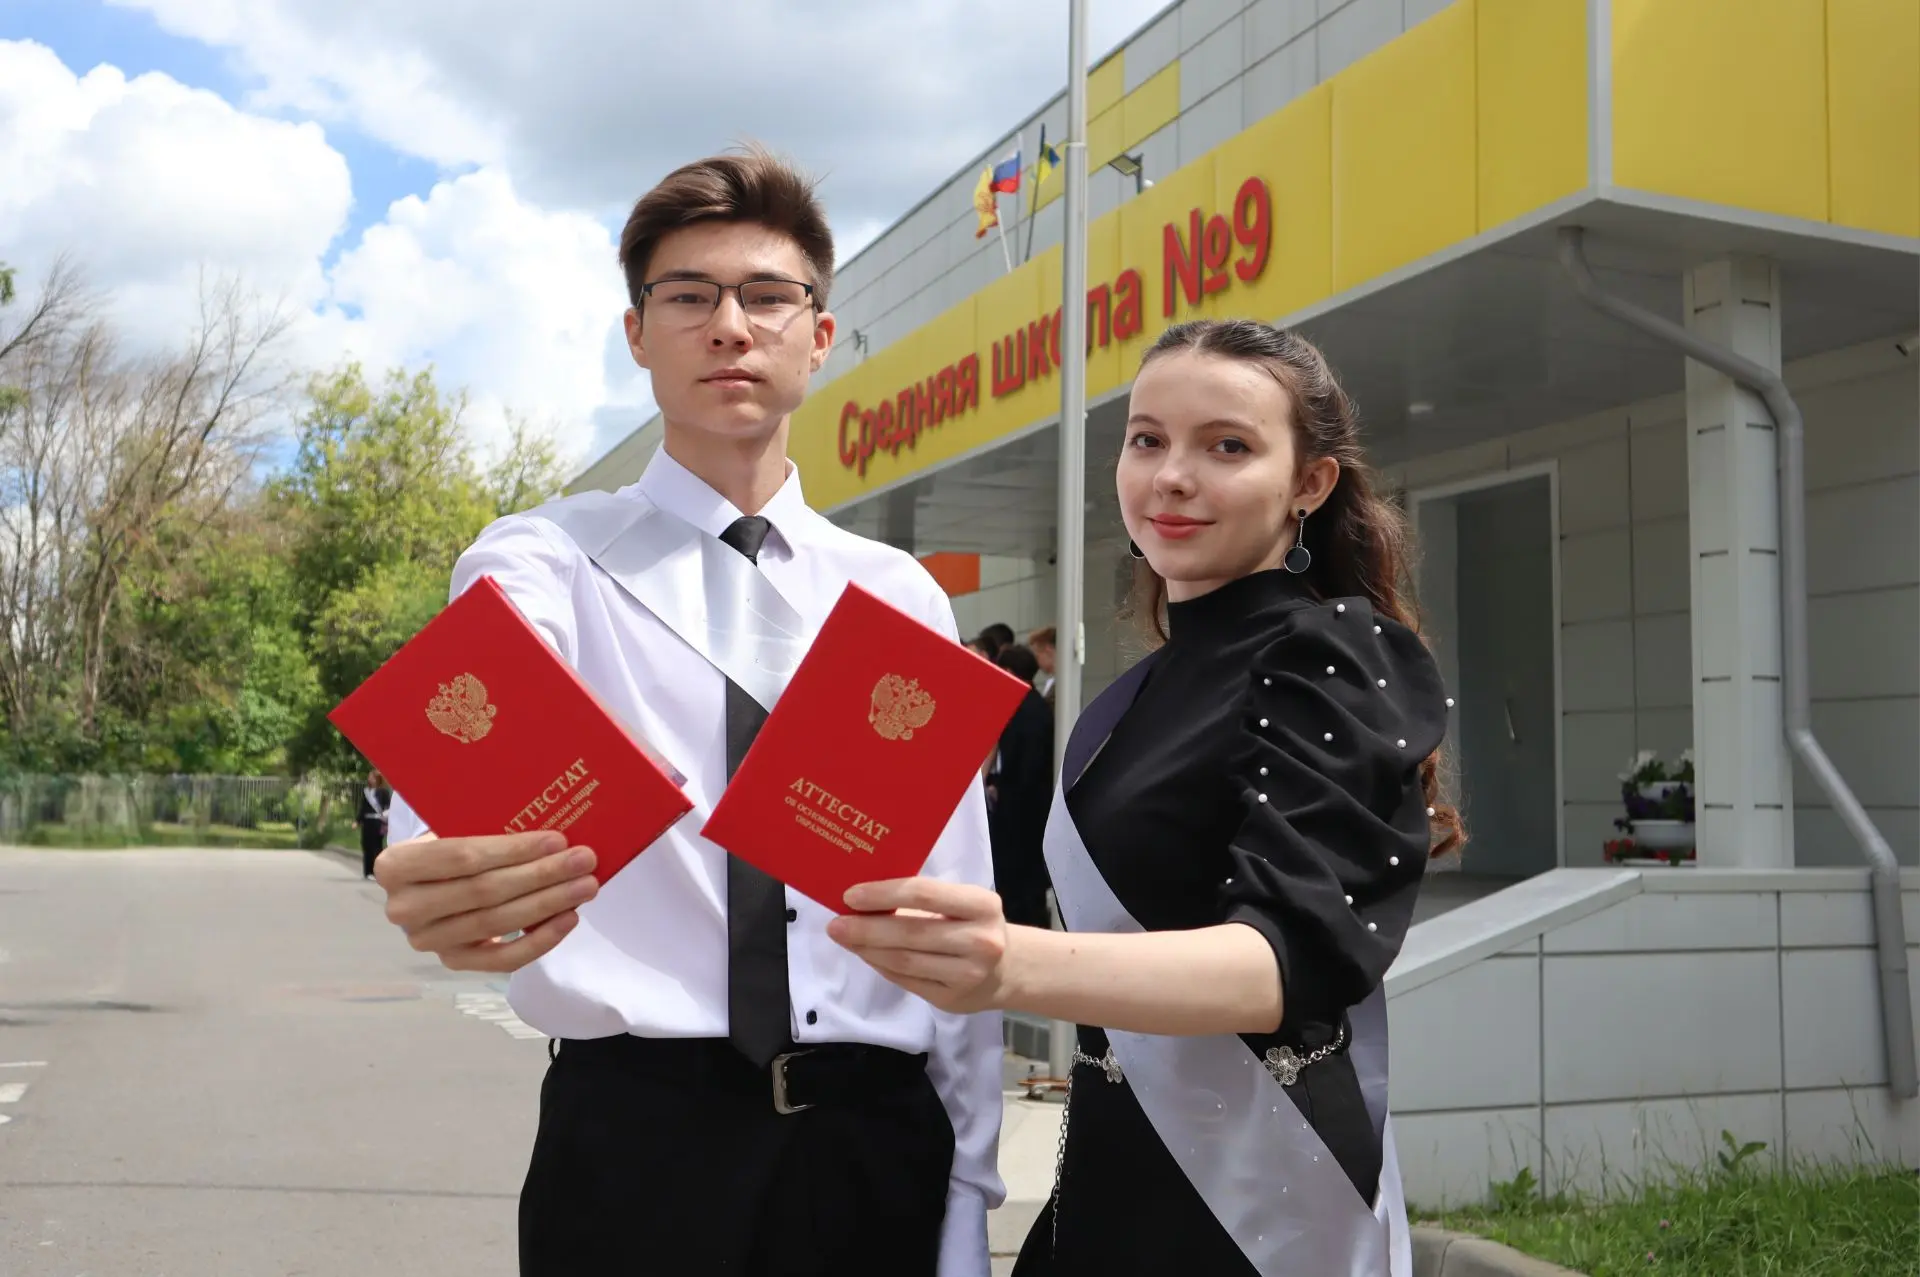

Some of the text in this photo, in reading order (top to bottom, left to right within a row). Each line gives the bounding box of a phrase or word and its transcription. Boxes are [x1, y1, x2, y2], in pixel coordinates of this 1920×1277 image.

[838, 352, 979, 476] Средняя
[1163, 176, 1271, 317] №9
[504, 758, 589, 835] АТТЕСТАТ
[789, 777, 890, 841] АТТЕСТАТ
[797, 803, 844, 836] ОСНОВНОМ
